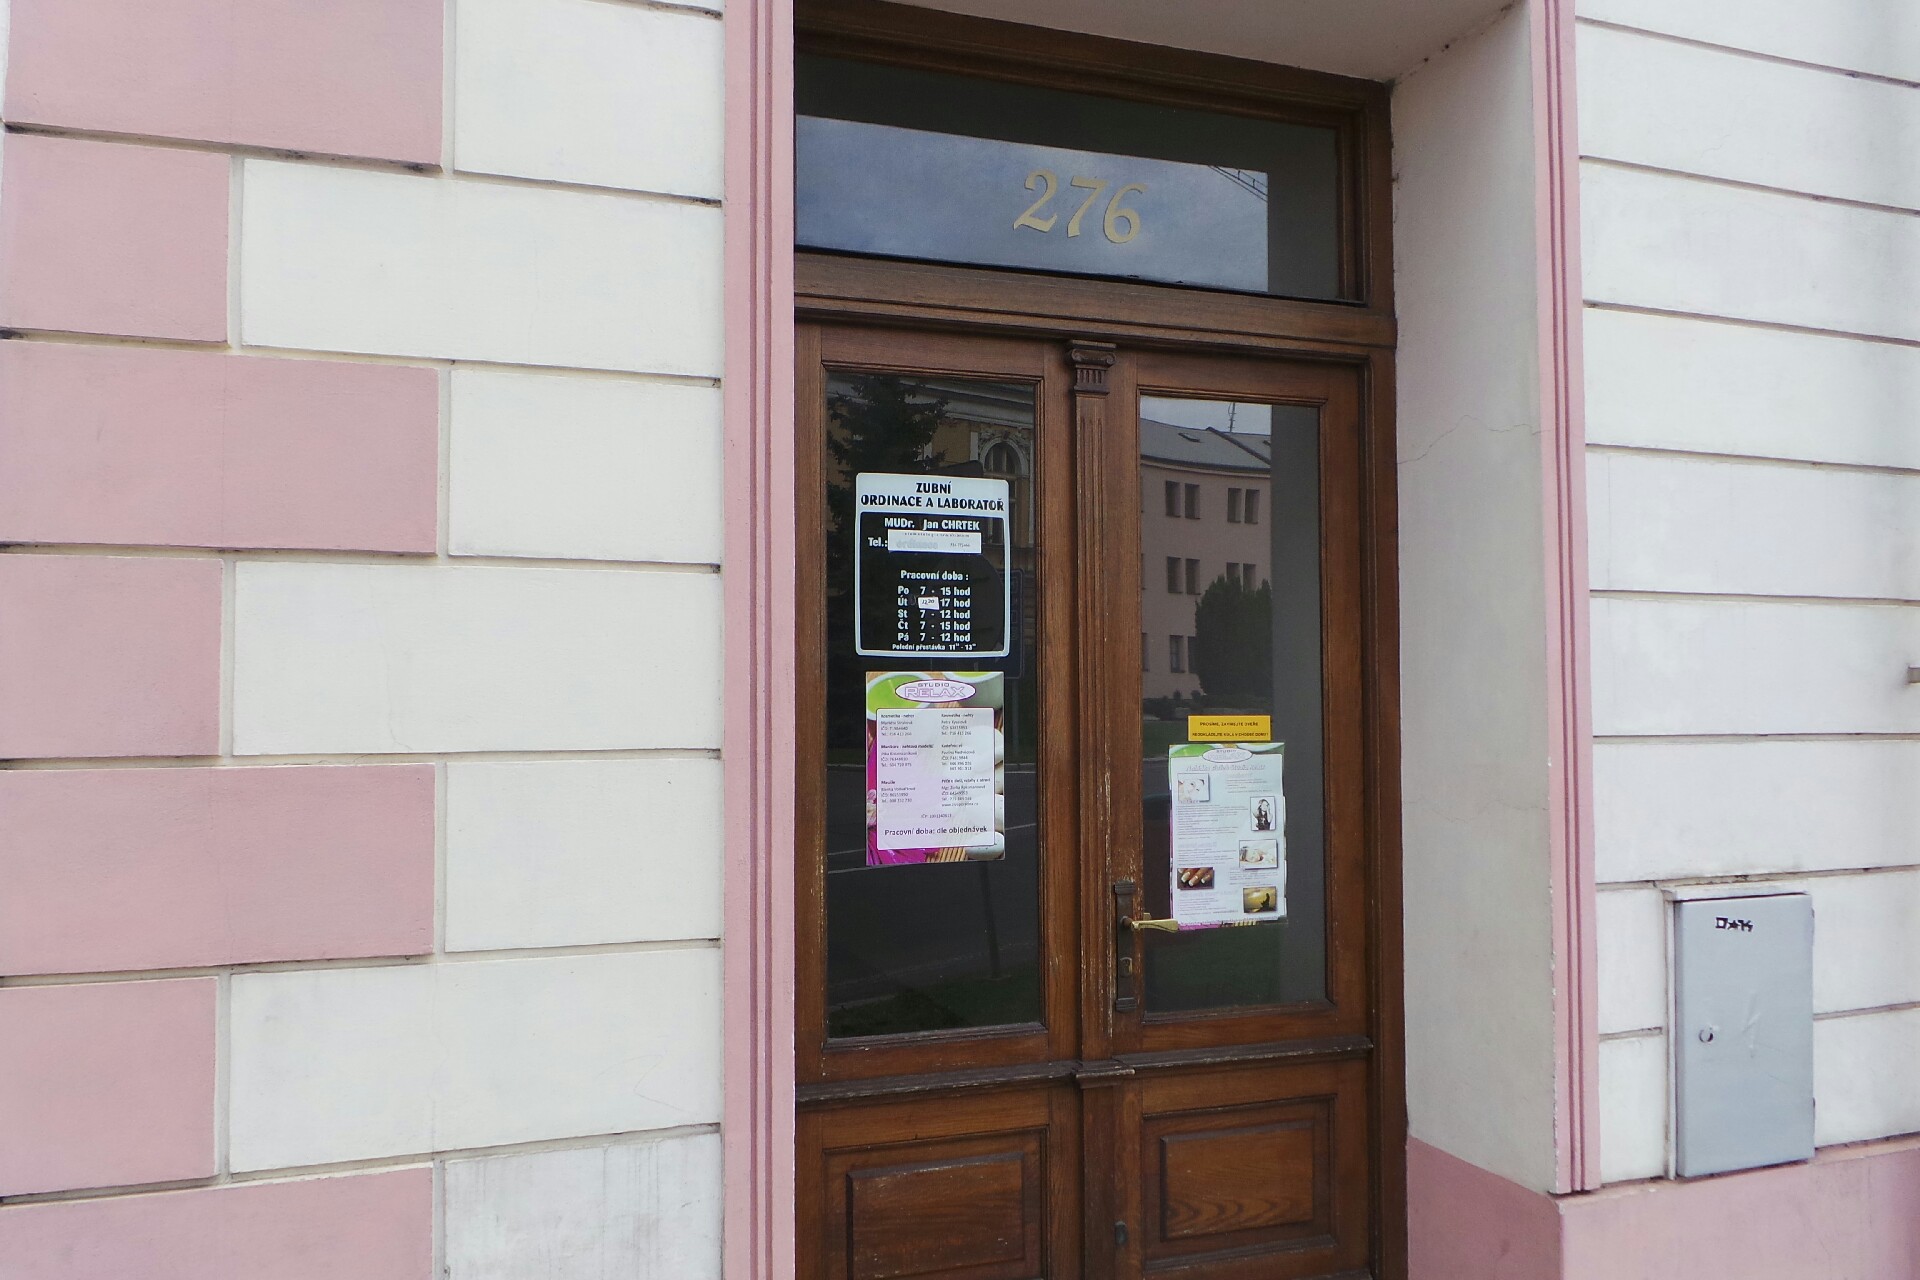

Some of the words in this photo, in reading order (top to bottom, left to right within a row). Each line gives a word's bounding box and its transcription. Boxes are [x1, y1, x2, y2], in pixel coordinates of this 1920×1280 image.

[1013, 168, 1148, 244] 276
[916, 481, 952, 495] ZUBNÍ
[861, 495, 922, 507] ORDINACE
[926, 497, 933, 508] A
[938, 498, 1005, 511] LABORATOŘ
[885, 518, 915, 528] MUDr.
[923, 519, 939, 531] Jan
[942, 520, 980, 531] CHRTEK
[868, 537, 888, 547] Tel.:
[901, 570, 940, 580] Pracovní
[942, 571, 964, 581] doba
[898, 586, 909, 595] Po
[920, 587, 926, 595] 7
[940, 587, 951, 596] 15
[954, 587, 970, 596] hod
[898, 595, 908, 606] Út
[940, 598, 951, 608] 17
[954, 598, 970, 608] hod
[898, 609, 908, 618] St
[920, 610, 926, 618] 7
[940, 610, 951, 619] 12
[954, 610, 970, 619] hod
[898, 620, 908, 630] Čt
[920, 621, 926, 629] 7
[940, 621, 951, 630] 15
[954, 621, 970, 630] hod
[898, 632, 909, 641] Pá
[920, 633, 926, 641] 7
[940, 633, 951, 642] 12
[954, 633, 970, 642] hod
[916, 643, 946, 652] přestávka
[904, 687, 965, 697] RELAX
[884, 828, 914, 836] Pracovní
[915, 827, 935, 835] doba:
[936, 826, 947, 834] dle
[948, 825, 988, 835] objednávek
